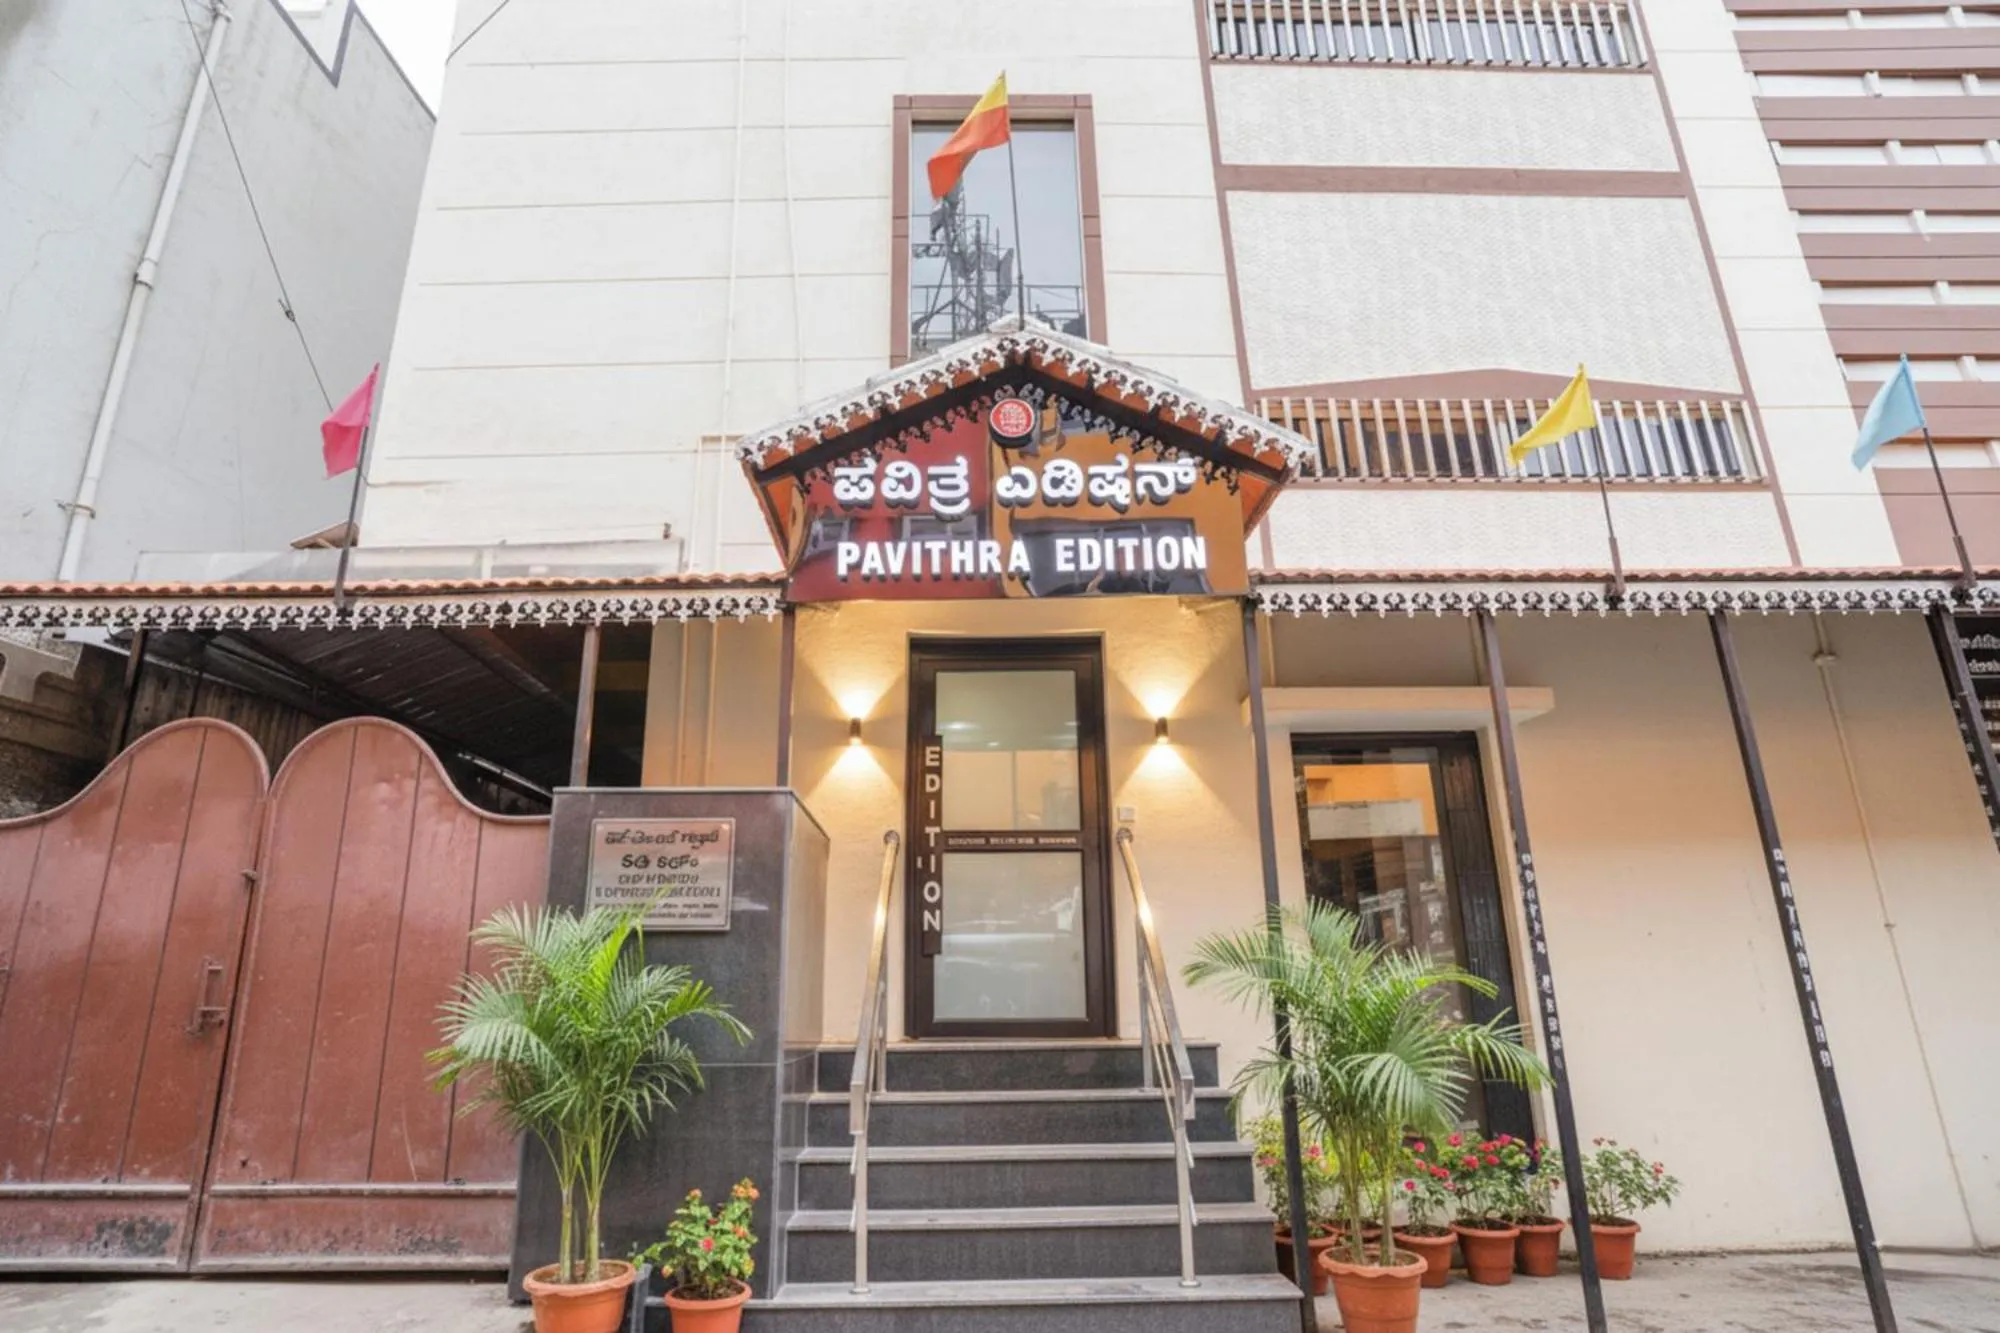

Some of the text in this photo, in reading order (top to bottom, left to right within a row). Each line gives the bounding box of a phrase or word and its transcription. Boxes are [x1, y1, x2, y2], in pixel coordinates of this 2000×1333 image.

[837, 536, 1208, 577] PAVITHRA EDITION
[923, 746, 941, 932] EDITION
